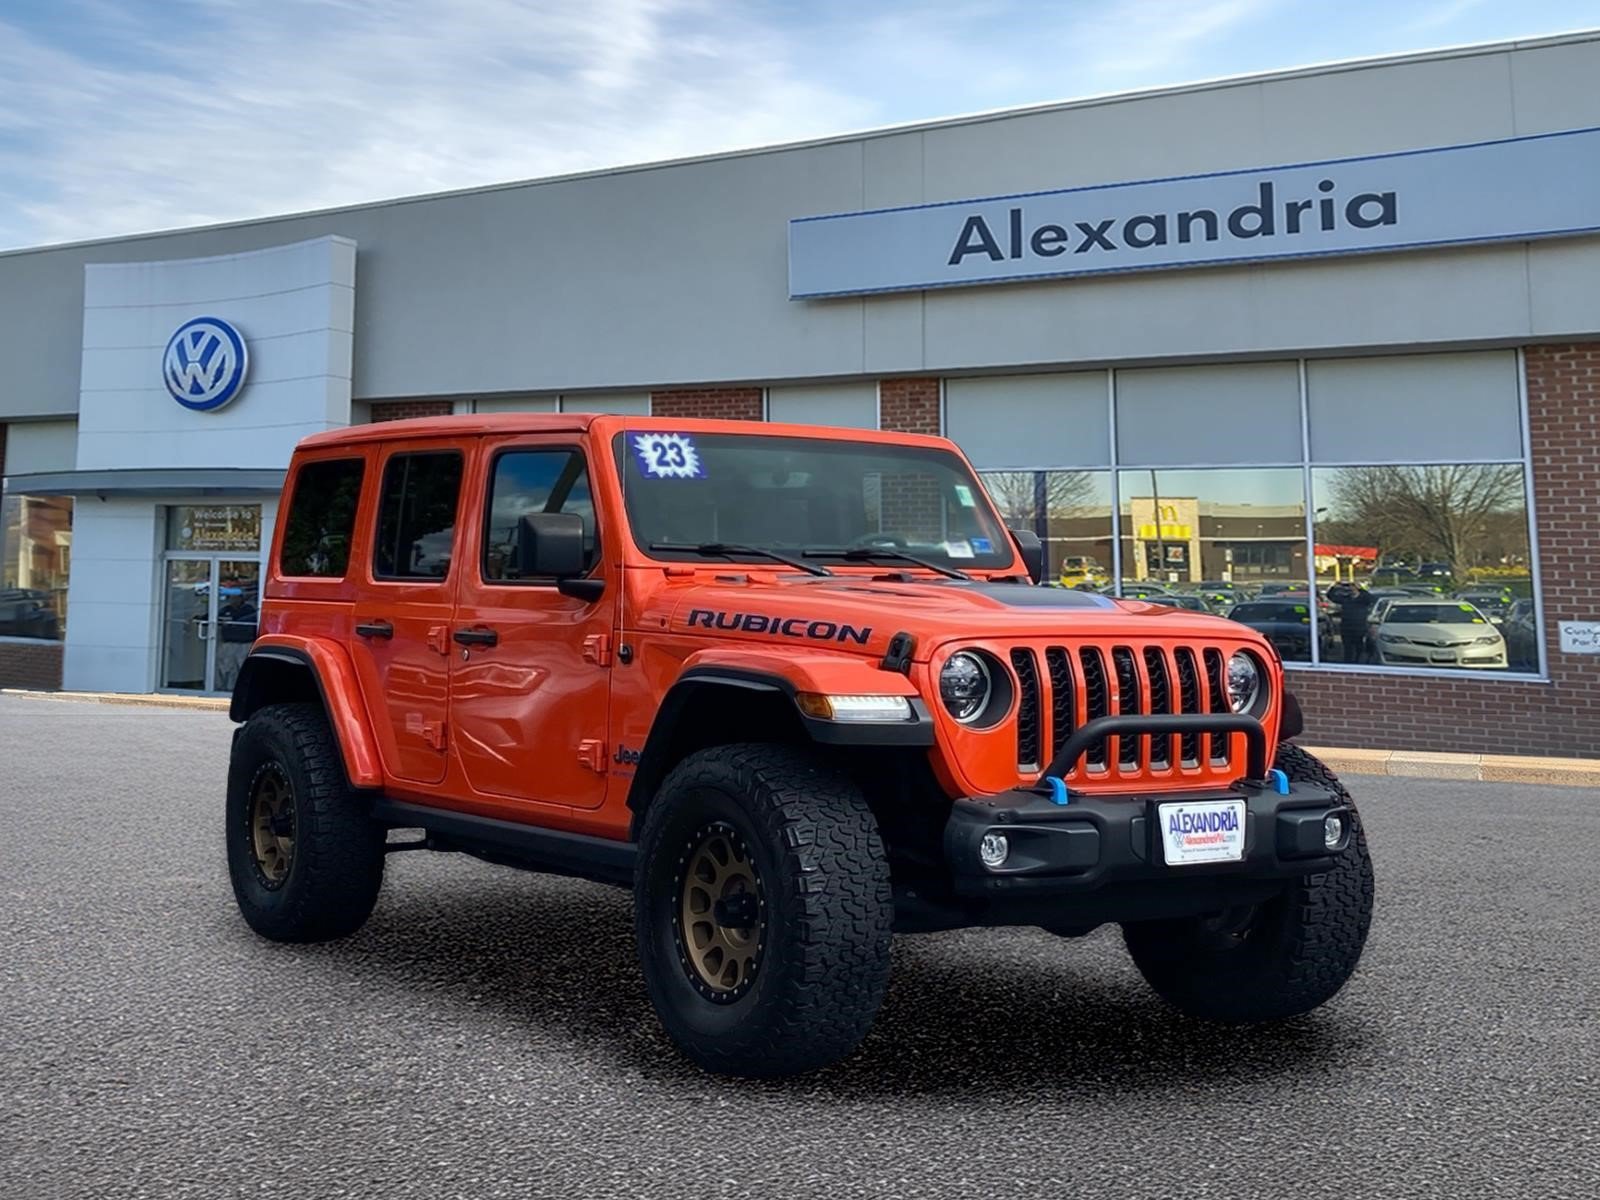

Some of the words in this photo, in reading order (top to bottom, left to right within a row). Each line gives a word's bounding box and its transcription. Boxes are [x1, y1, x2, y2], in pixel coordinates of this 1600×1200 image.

[947, 179, 1398, 266] Alexandria
[652, 441, 686, 468] 23
[687, 608, 873, 645] RUBICON
[613, 743, 641, 765] Jee
[1169, 810, 1239, 835] ALEXANDRIA
